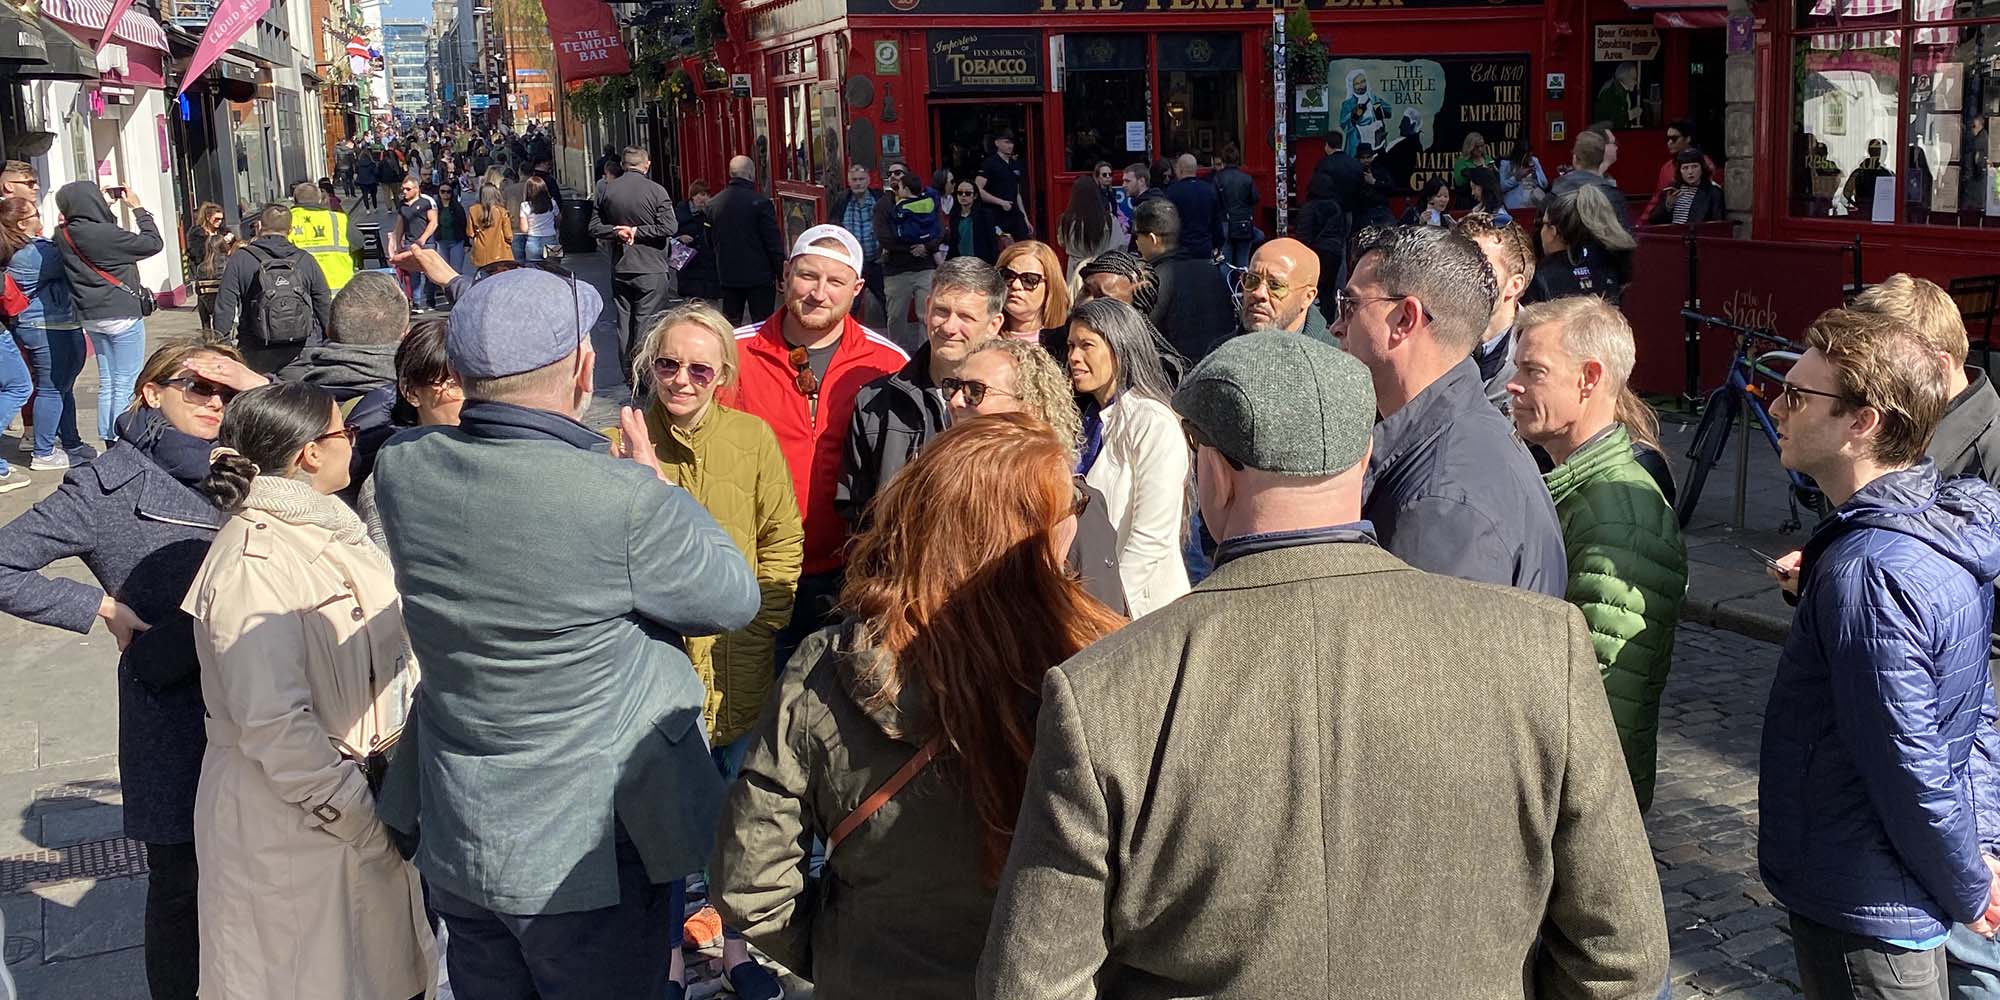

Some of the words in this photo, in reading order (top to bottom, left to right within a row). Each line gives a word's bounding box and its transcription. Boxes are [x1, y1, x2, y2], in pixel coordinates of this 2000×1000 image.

[209, 11, 240, 44] CLOUD
[576, 30, 600, 40] THE
[560, 36, 619, 53] TEMPLE
[932, 35, 978, 55] Importers
[973, 49, 990, 57] FINE
[992, 48, 1026, 57] SMOKING
[579, 49, 609, 62] BAR
[1603, 50, 1623, 60] Area
[946, 54, 1028, 81] TOBACCO
[1394, 65, 1424, 79] THE
[1499, 64, 1525, 81] 1840
[1380, 79, 1437, 92] TEMPLE
[1493, 85, 1522, 103] THE
[1394, 92, 1424, 105] BAR
[1460, 104, 1522, 122] EMPEROR
[1505, 122, 1521, 139] OF
